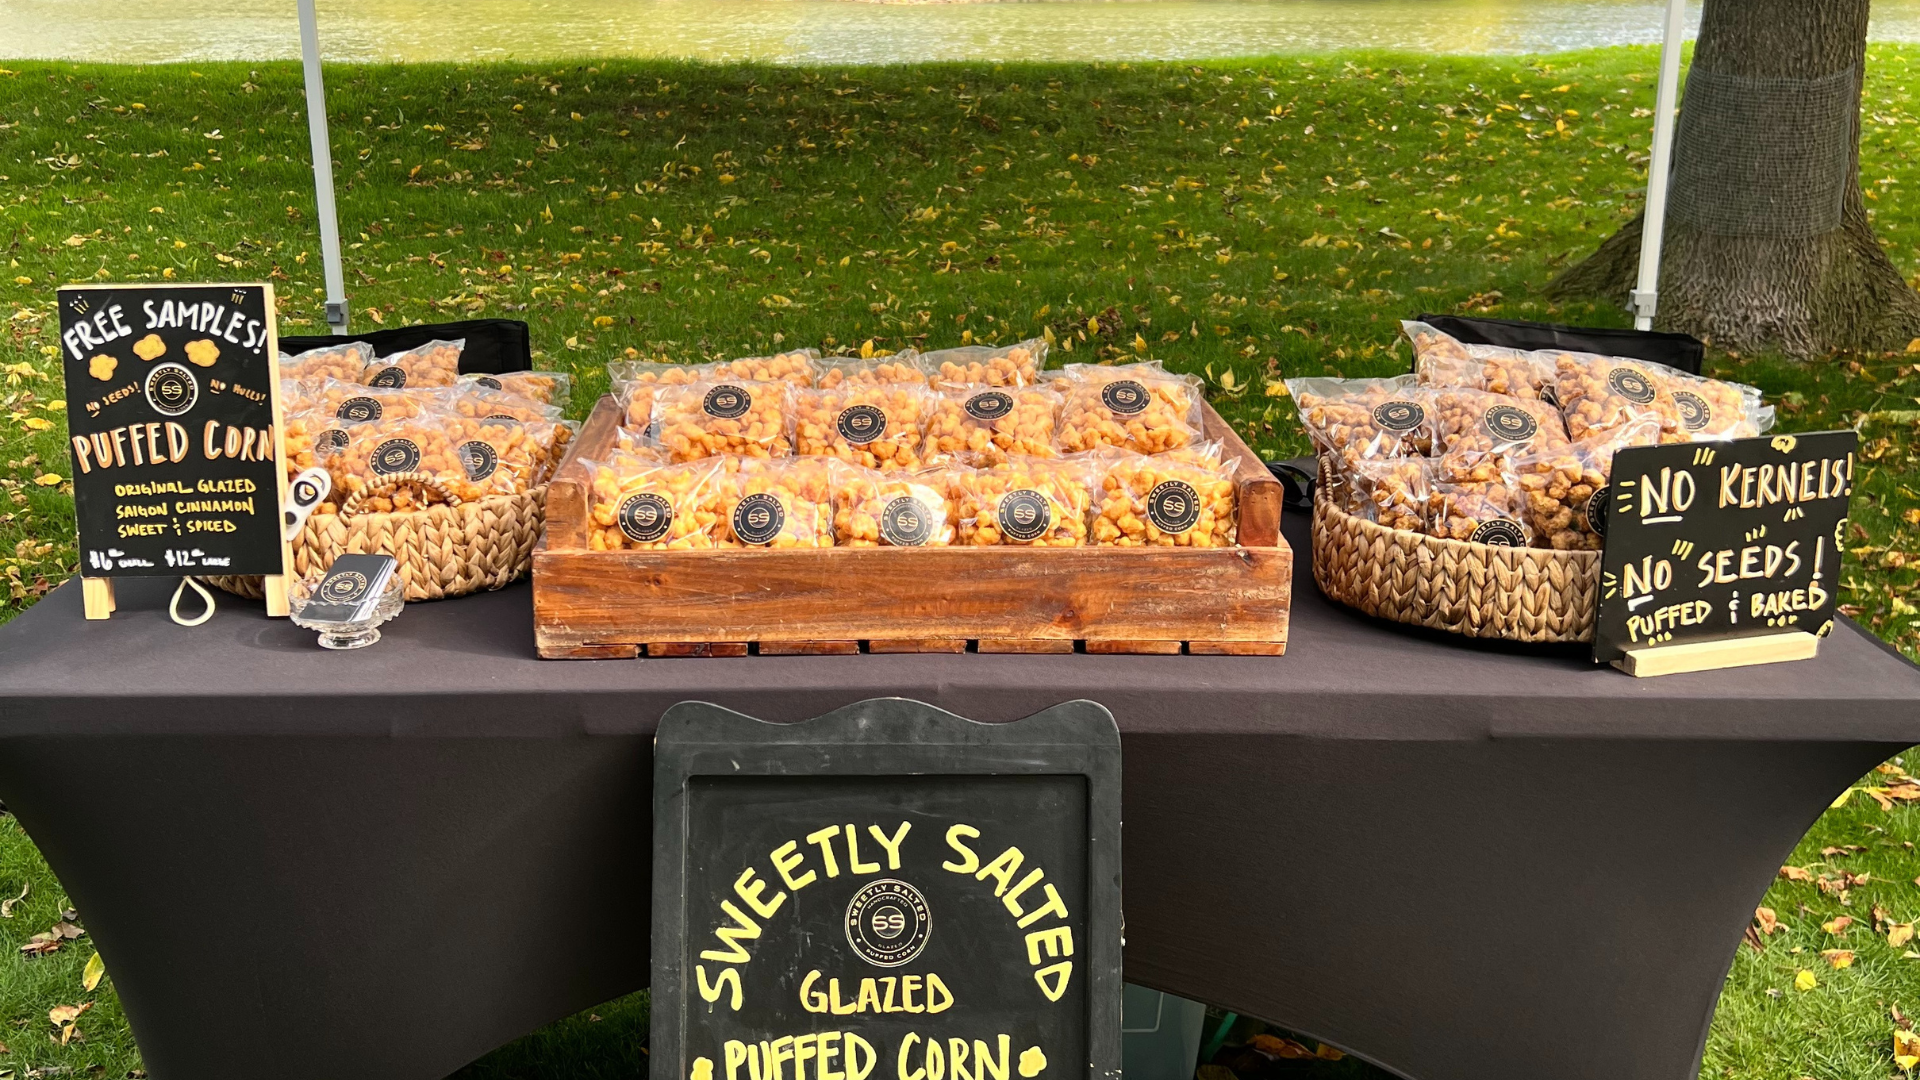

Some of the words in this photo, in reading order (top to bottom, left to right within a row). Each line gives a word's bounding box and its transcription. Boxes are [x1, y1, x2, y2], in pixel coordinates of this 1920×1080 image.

[63, 304, 132, 361] FREE
[143, 299, 267, 354] SAMPLES!
[161, 385, 182, 394] SS
[210, 378, 227, 391] NO
[85, 401, 100, 413] NO
[102, 381, 141, 406] SEEDS!
[716, 396, 738, 406] SS
[1115, 390, 1137, 400] SS
[349, 408, 369, 418] SS
[851, 418, 872, 427] SS
[1501, 416, 1522, 427] SS
[72, 421, 189, 474] PUFFED
[203, 420, 275, 463] CORN
[385, 451, 406, 465] SS
[114, 481, 194, 497] ORIGINAL
[197, 478, 257, 493] GLAZED
[1640, 466, 1696, 517] NO
[1719, 452, 1853, 508] KERNELS!
[620, 494, 650, 514] SWEETLY
[654, 495, 671, 518] SALTED
[1000, 491, 1027, 513] SWEETLY
[1031, 492, 1049, 516] SALTED
[1150, 482, 1178, 503] SWEETLY
[1182, 484, 1199, 511] SALTED
[1163, 500, 1186, 512] SS
[115, 502, 168, 519] SAIGON
[175, 497, 255, 515] CINNAMON
[635, 510, 657, 520] SS
[735, 495, 759, 520] SWEETLY
[763, 495, 783, 517] SALTED
[884, 498, 909, 520] SWEETLY
[1014, 508, 1036, 519] SS
[748, 512, 770, 523] SS
[897, 516, 918, 527] SS
[117, 523, 168, 538] SWEET
[186, 519, 237, 533] SPICED
[1474, 522, 1500, 540] WEETLY
[1623, 555, 1672, 598] NO
[1626, 600, 1713, 642] PUFFED
[1751, 588, 1828, 618] BAKED
[850, 884, 887, 926] SWEETLY
[894, 885, 927, 921] SALTED
[695, 821, 912, 1012] SWEETLY
[942, 824, 1074, 1002] SALTED
[872, 914, 905, 931] SS
[800, 970, 954, 1015] GLAZED
[724, 1031, 877, 1080] PUFFED
[897, 1032, 1010, 1080] CORN
